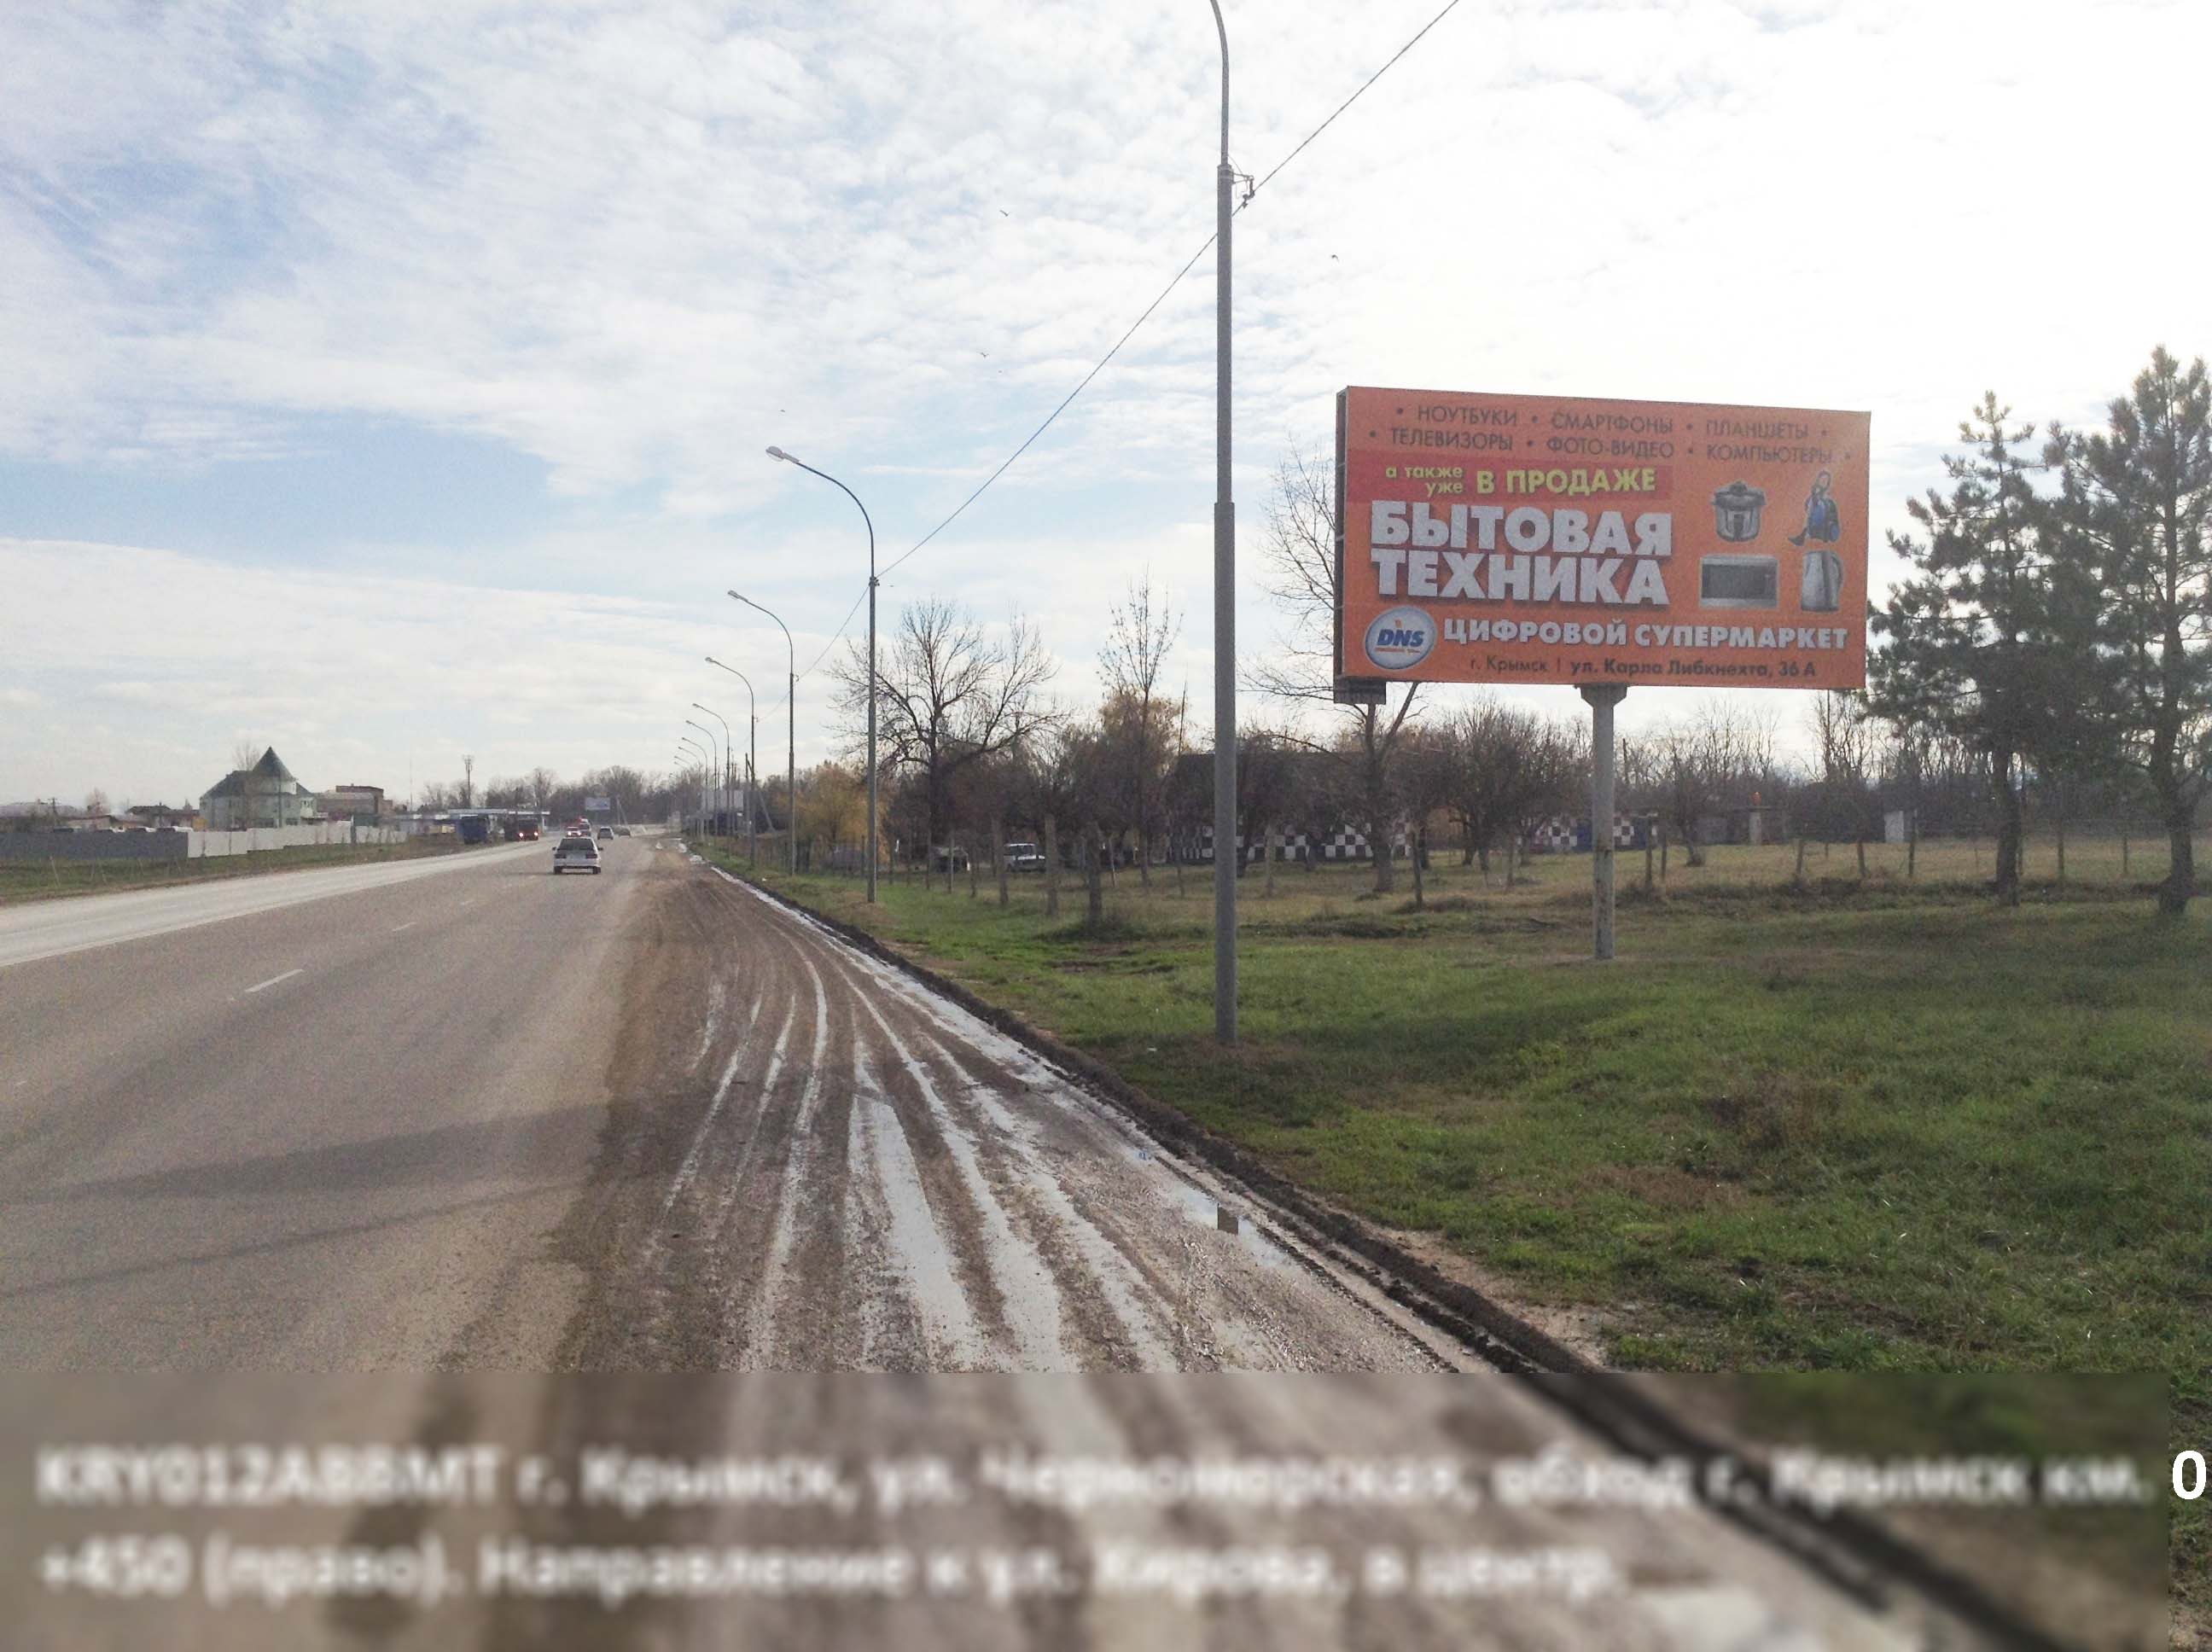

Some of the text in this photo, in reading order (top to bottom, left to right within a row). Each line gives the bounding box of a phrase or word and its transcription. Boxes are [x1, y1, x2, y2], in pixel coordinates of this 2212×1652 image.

[1417, 405, 1809, 439] НОУТБУКИ СМАРТФОНЫ ПЛАНШЕТЫ
[1391, 428, 1833, 464] ТЕЛЕВИЗОРЫ ФОТО-ВИДЕО КОМПЬЮТЕРЫ
[1386, 466, 1464, 479] а также
[1477, 468, 1656, 497] В ПРОДАЖЕ
[1426, 481, 1464, 496] уже
[1371, 499, 1673, 556] БЫТОВАЯ
[1371, 548, 1670, 606] ТЕХНИКА
[1377, 628, 1425, 648] DNS
[1444, 618, 1848, 649] ЦИФРОВОЙ СУПЕРМАРКЕТ
[1487, 654, 1548, 673] Крымск
[1569, 660, 1598, 676] ул.
[1604, 659, 1663, 677] Карла
